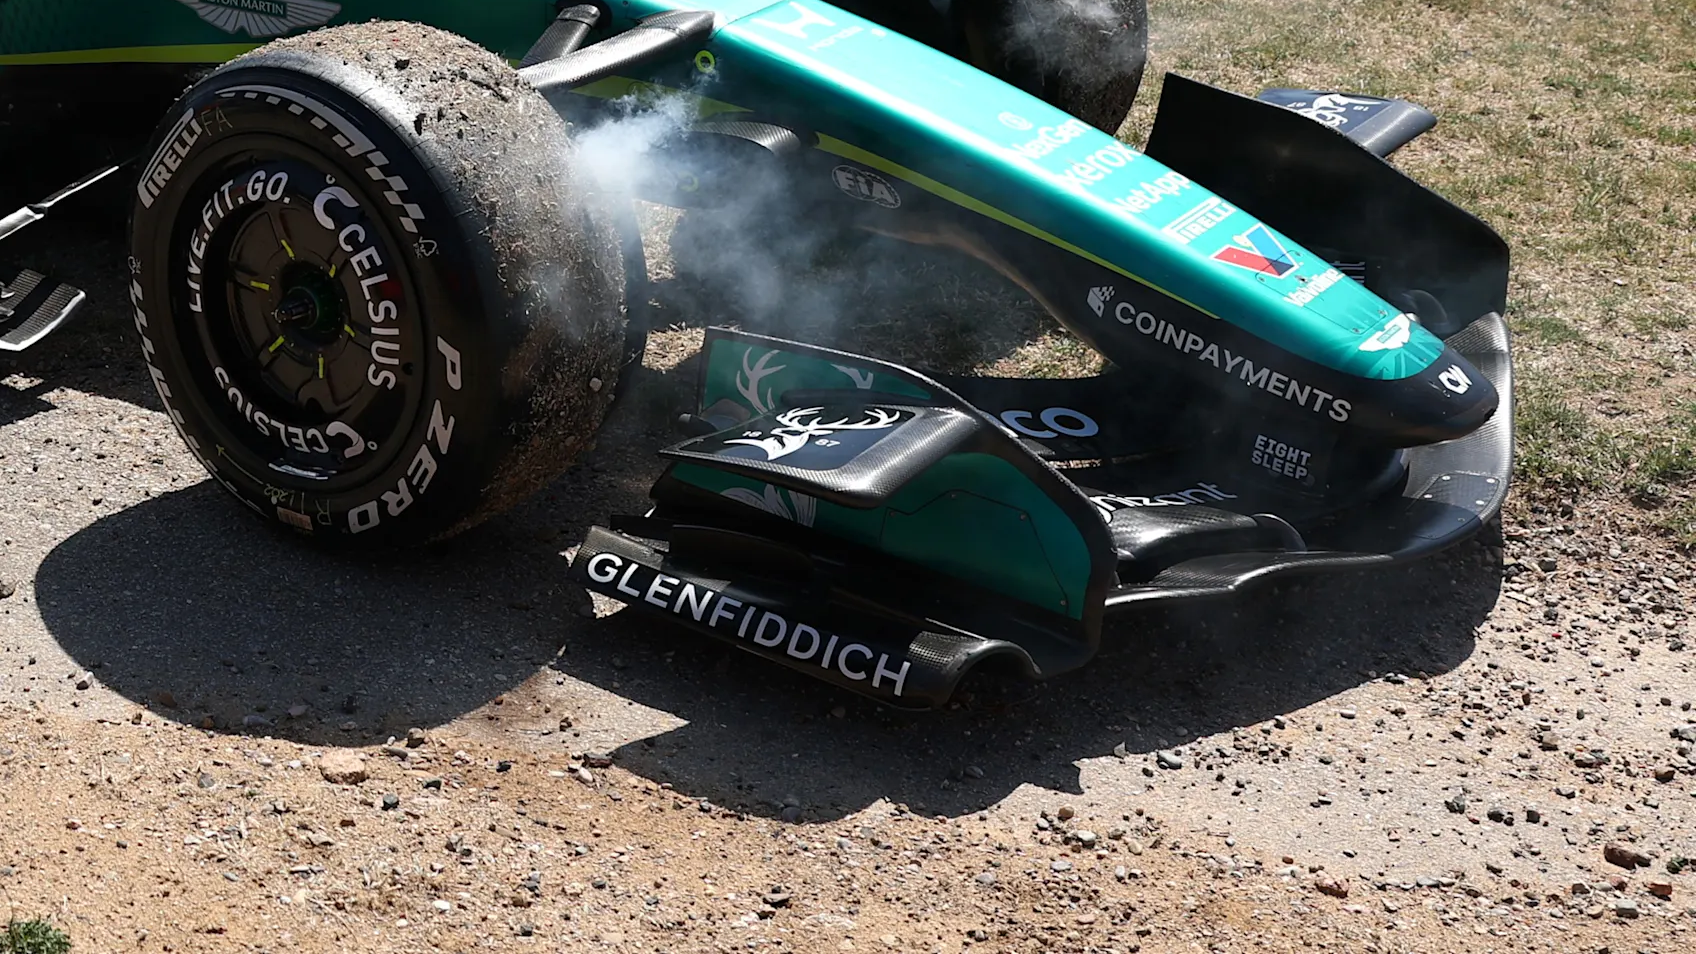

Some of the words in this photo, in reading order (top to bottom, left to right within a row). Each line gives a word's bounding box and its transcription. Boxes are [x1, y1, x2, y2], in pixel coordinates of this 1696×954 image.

[137, 108, 203, 209] PIRELLI
[1012, 117, 1093, 160] NexGen
[1058, 141, 1142, 194] xerox
[1110, 170, 1191, 216] NetApp
[188, 170, 292, 313] LIVE.FIT.GO.
[1161, 197, 1237, 244] PIRELLI
[338, 222, 400, 391] CELSIUS
[1283, 267, 1346, 308] Valvoline
[437, 335, 463, 391] P
[1114, 300, 1353, 424] COINPAYMENTS
[213, 365, 329, 454] CELSIUS
[347, 399, 455, 534] ZERO
[1252, 450, 1309, 480] SLEEP
[1255, 433, 1312, 466] EIGHT
[586, 552, 912, 697] GLENFIDDICH
